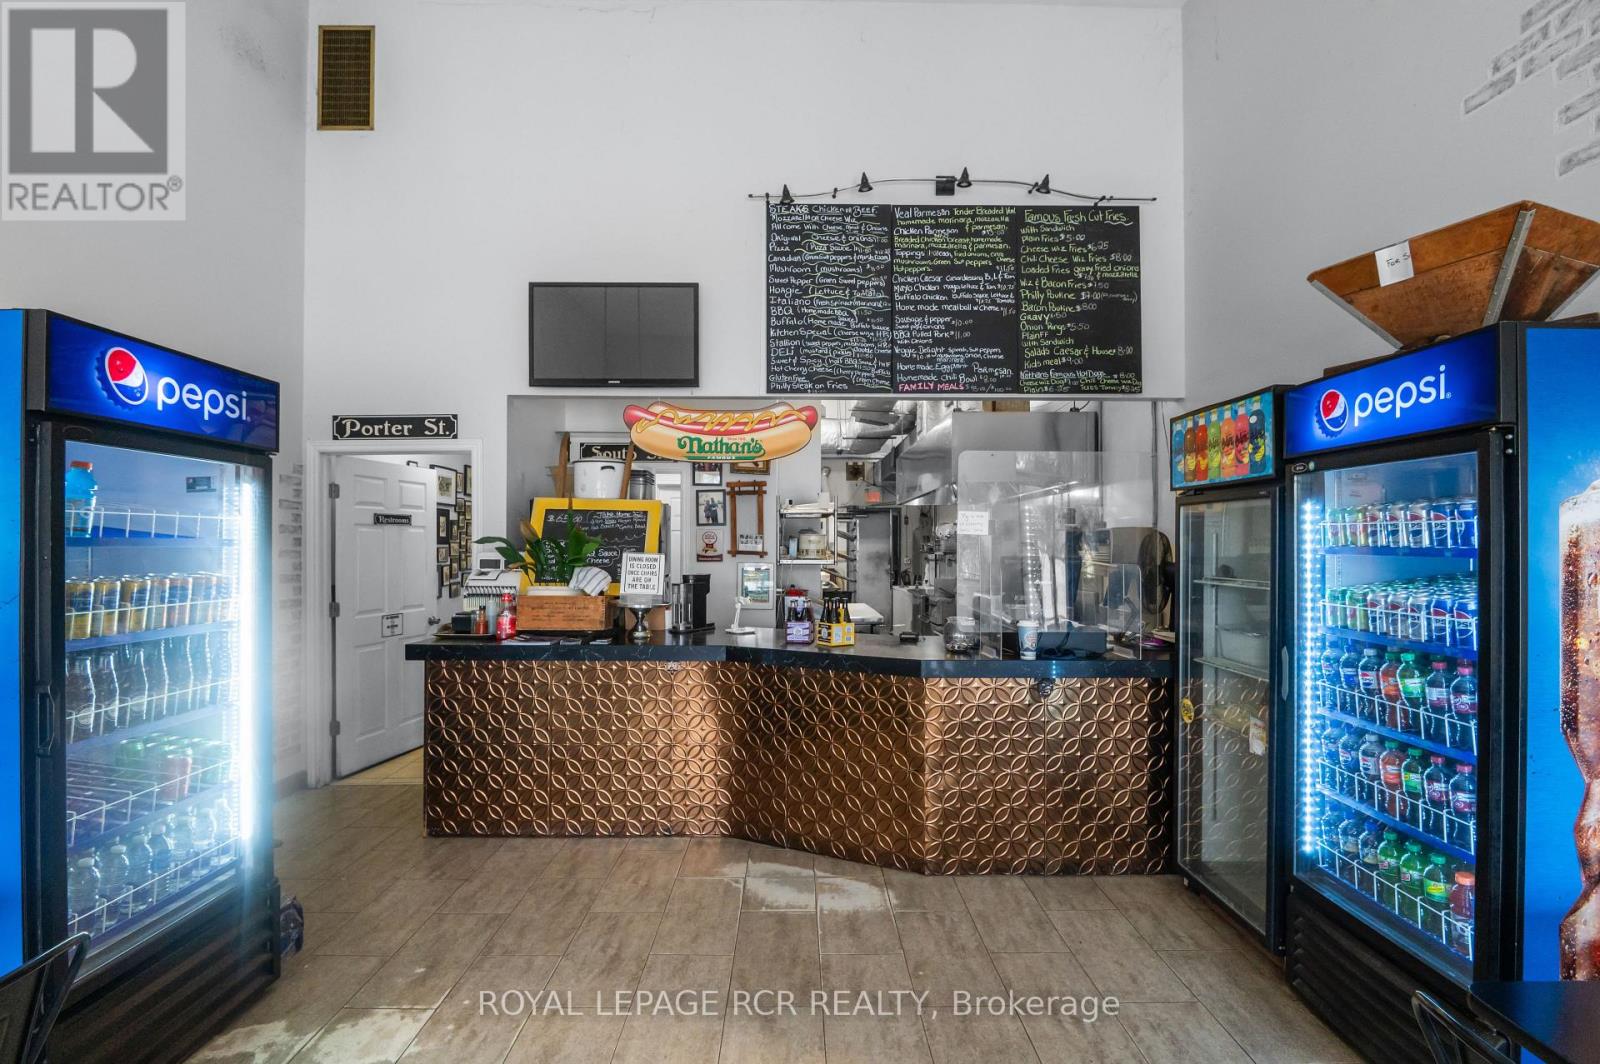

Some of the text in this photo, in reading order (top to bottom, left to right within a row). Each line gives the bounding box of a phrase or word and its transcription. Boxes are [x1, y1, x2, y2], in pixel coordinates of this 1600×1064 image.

[1025, 209, 1061, 222] Famous
[1064, 209, 1086, 222] Fresh
[1088, 210, 1103, 222] Cut
[1041, 234, 1058, 242] Fries
[1069, 244, 1087, 253] Fries
[1040, 255, 1069, 263] Cheese
[1088, 254, 1106, 262] Fries
[1052, 265, 1070, 273] Fries
[1041, 276, 1067, 288] Bacon
[1068, 280, 1086, 289] Fries
[1021, 290, 1045, 305] Philly
[771, 307, 793, 315] BBQ
[1021, 303, 1048, 312] Bacon
[771, 317, 803, 326] Buffalo
[1020, 322, 1043, 331] Onion
[893, 331, 910, 339] BBQ
[1025, 348, 1050, 358] Salads
[898, 382, 934, 391] FAMILY
[937, 382, 965, 391] MEALS
[157, 377, 248, 421] pepsi
[342, 418, 450, 438] Porter St.
[677, 436, 766, 456] Nathan's
[640, 583, 656, 591] TABLE
